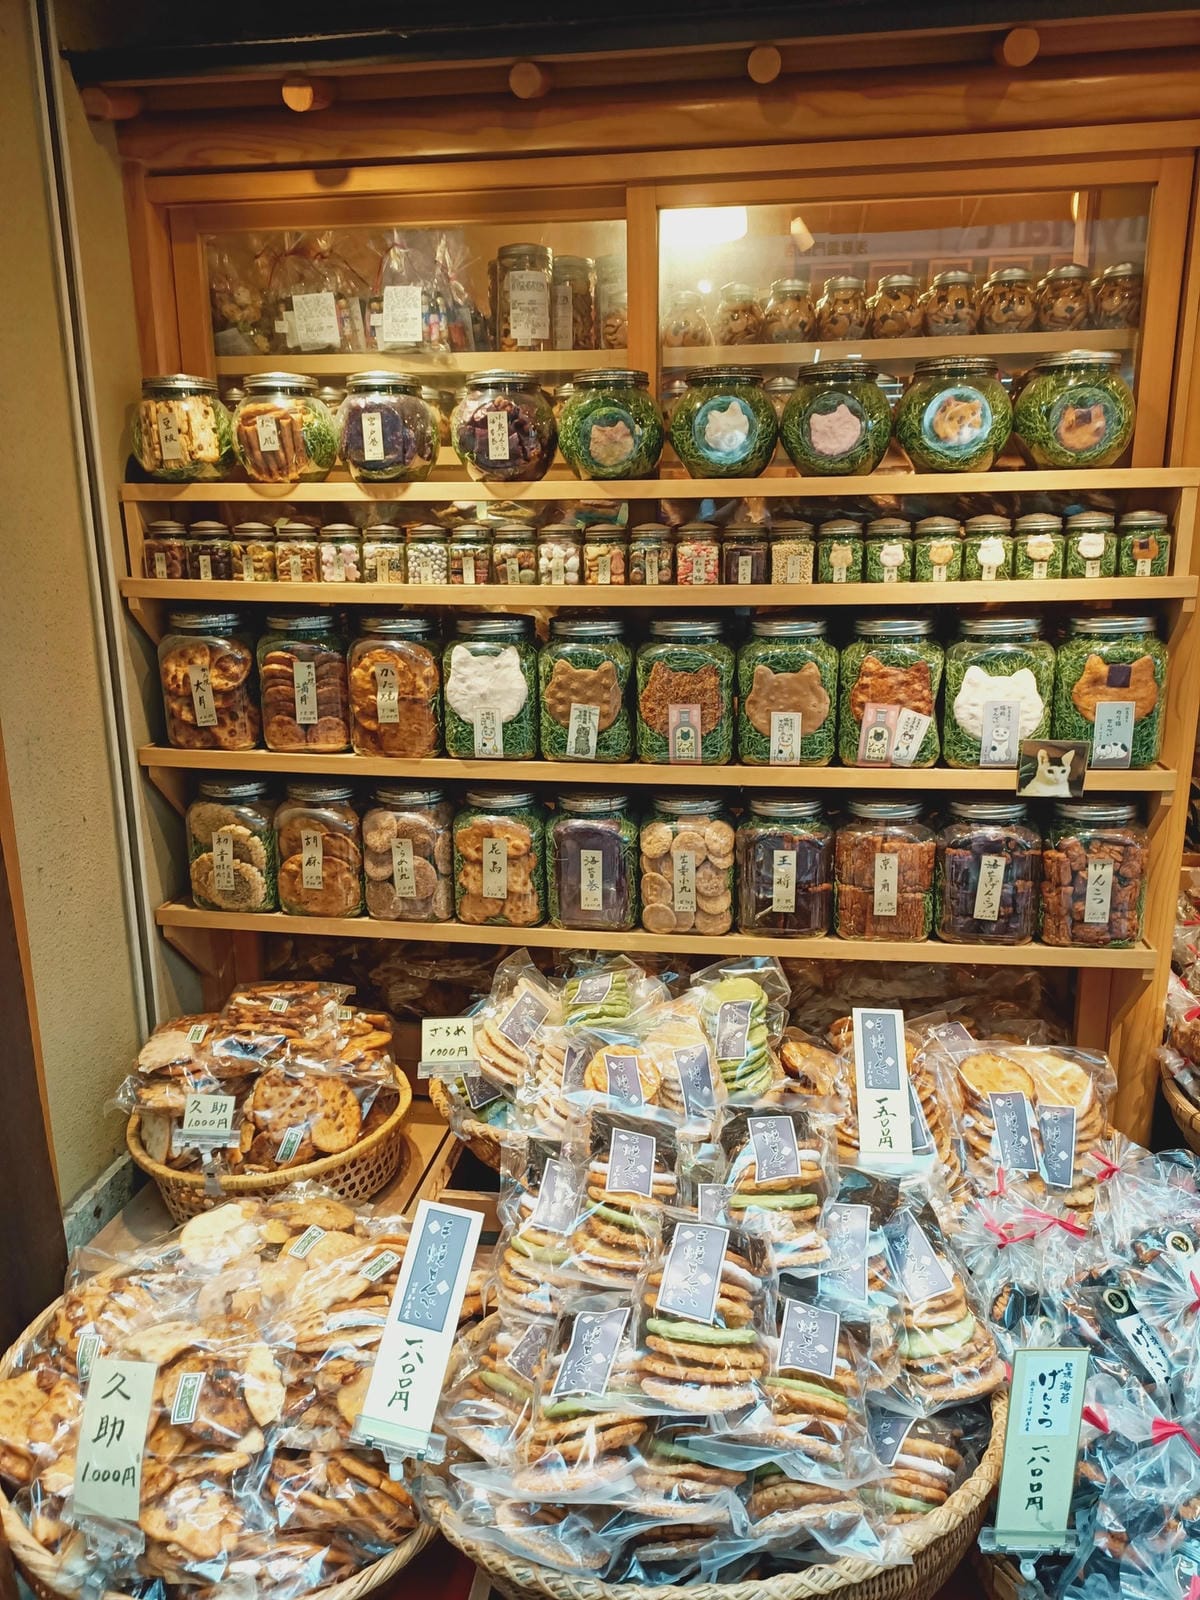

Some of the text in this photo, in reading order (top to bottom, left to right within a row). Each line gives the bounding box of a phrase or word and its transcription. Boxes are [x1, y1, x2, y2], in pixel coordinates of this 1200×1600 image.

[380, 668, 397, 702] かた焼
[304, 836, 320, 868] 胡麻
[777, 855, 792, 890] 王将
[1092, 862, 1112, 905] げんこつ
[429, 1025, 467, 1038] ざらめ
[189, 1099, 228, 1115] 久助
[92, 1371, 131, 1448] 久助
[1038, 1369, 1064, 1428] げんこつ
